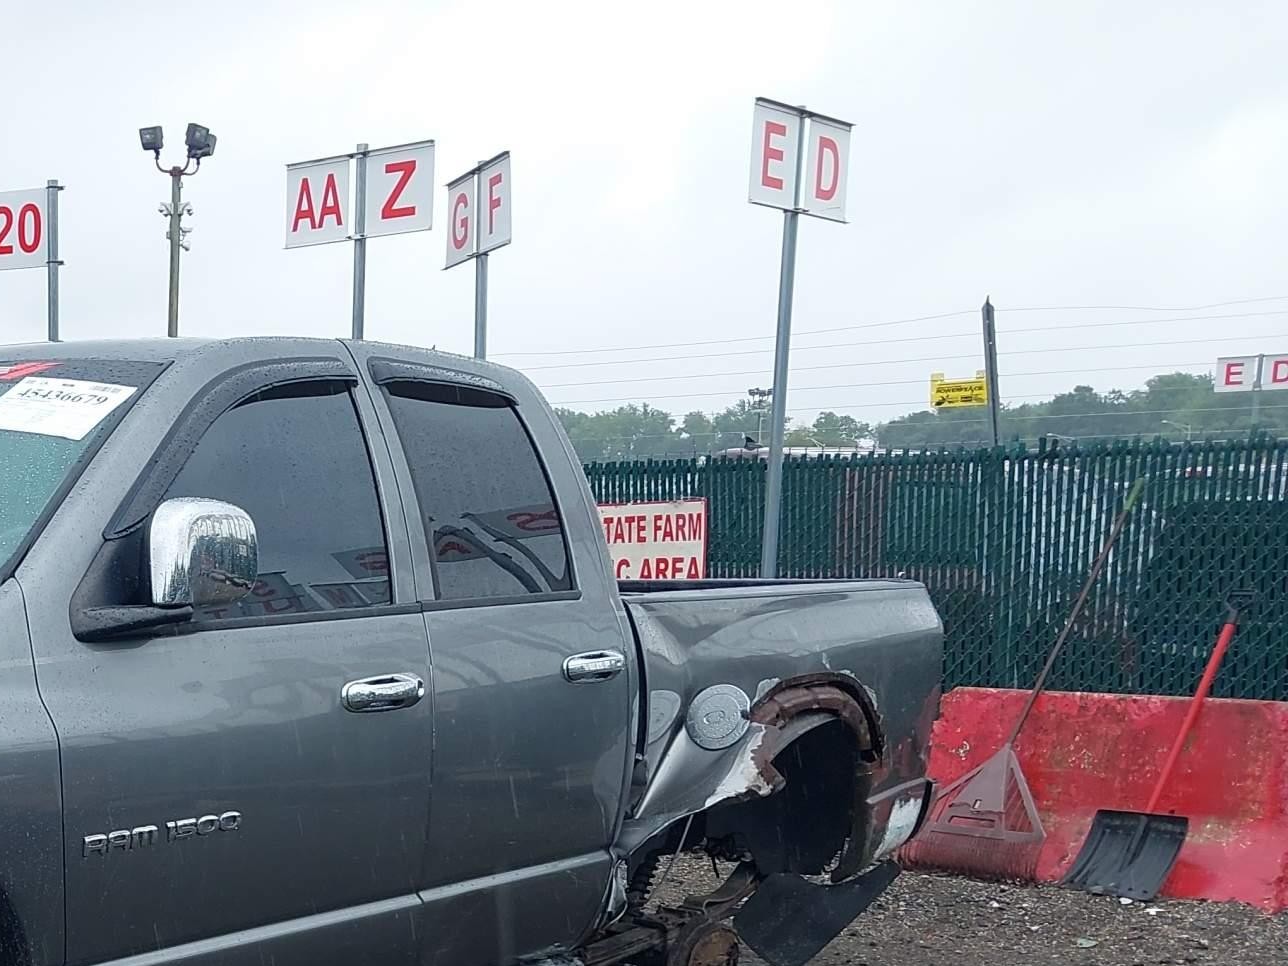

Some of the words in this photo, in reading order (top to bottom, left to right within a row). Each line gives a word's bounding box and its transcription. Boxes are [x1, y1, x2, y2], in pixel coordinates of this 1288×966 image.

[760, 120, 787, 190] E
[813, 134, 841, 202] D
[291, 173, 344, 232] AA
[379, 159, 418, 220] Z
[487, 173, 503, 235] F
[451, 192, 470, 250] G
[1224, 362, 1245, 386] E
[603, 515, 647, 544] TATE
[653, 513, 702, 542] FARM
[639, 556, 700, 579] AREA
[82, 824, 158, 858] RAM
[165, 810, 242, 843] 1500
